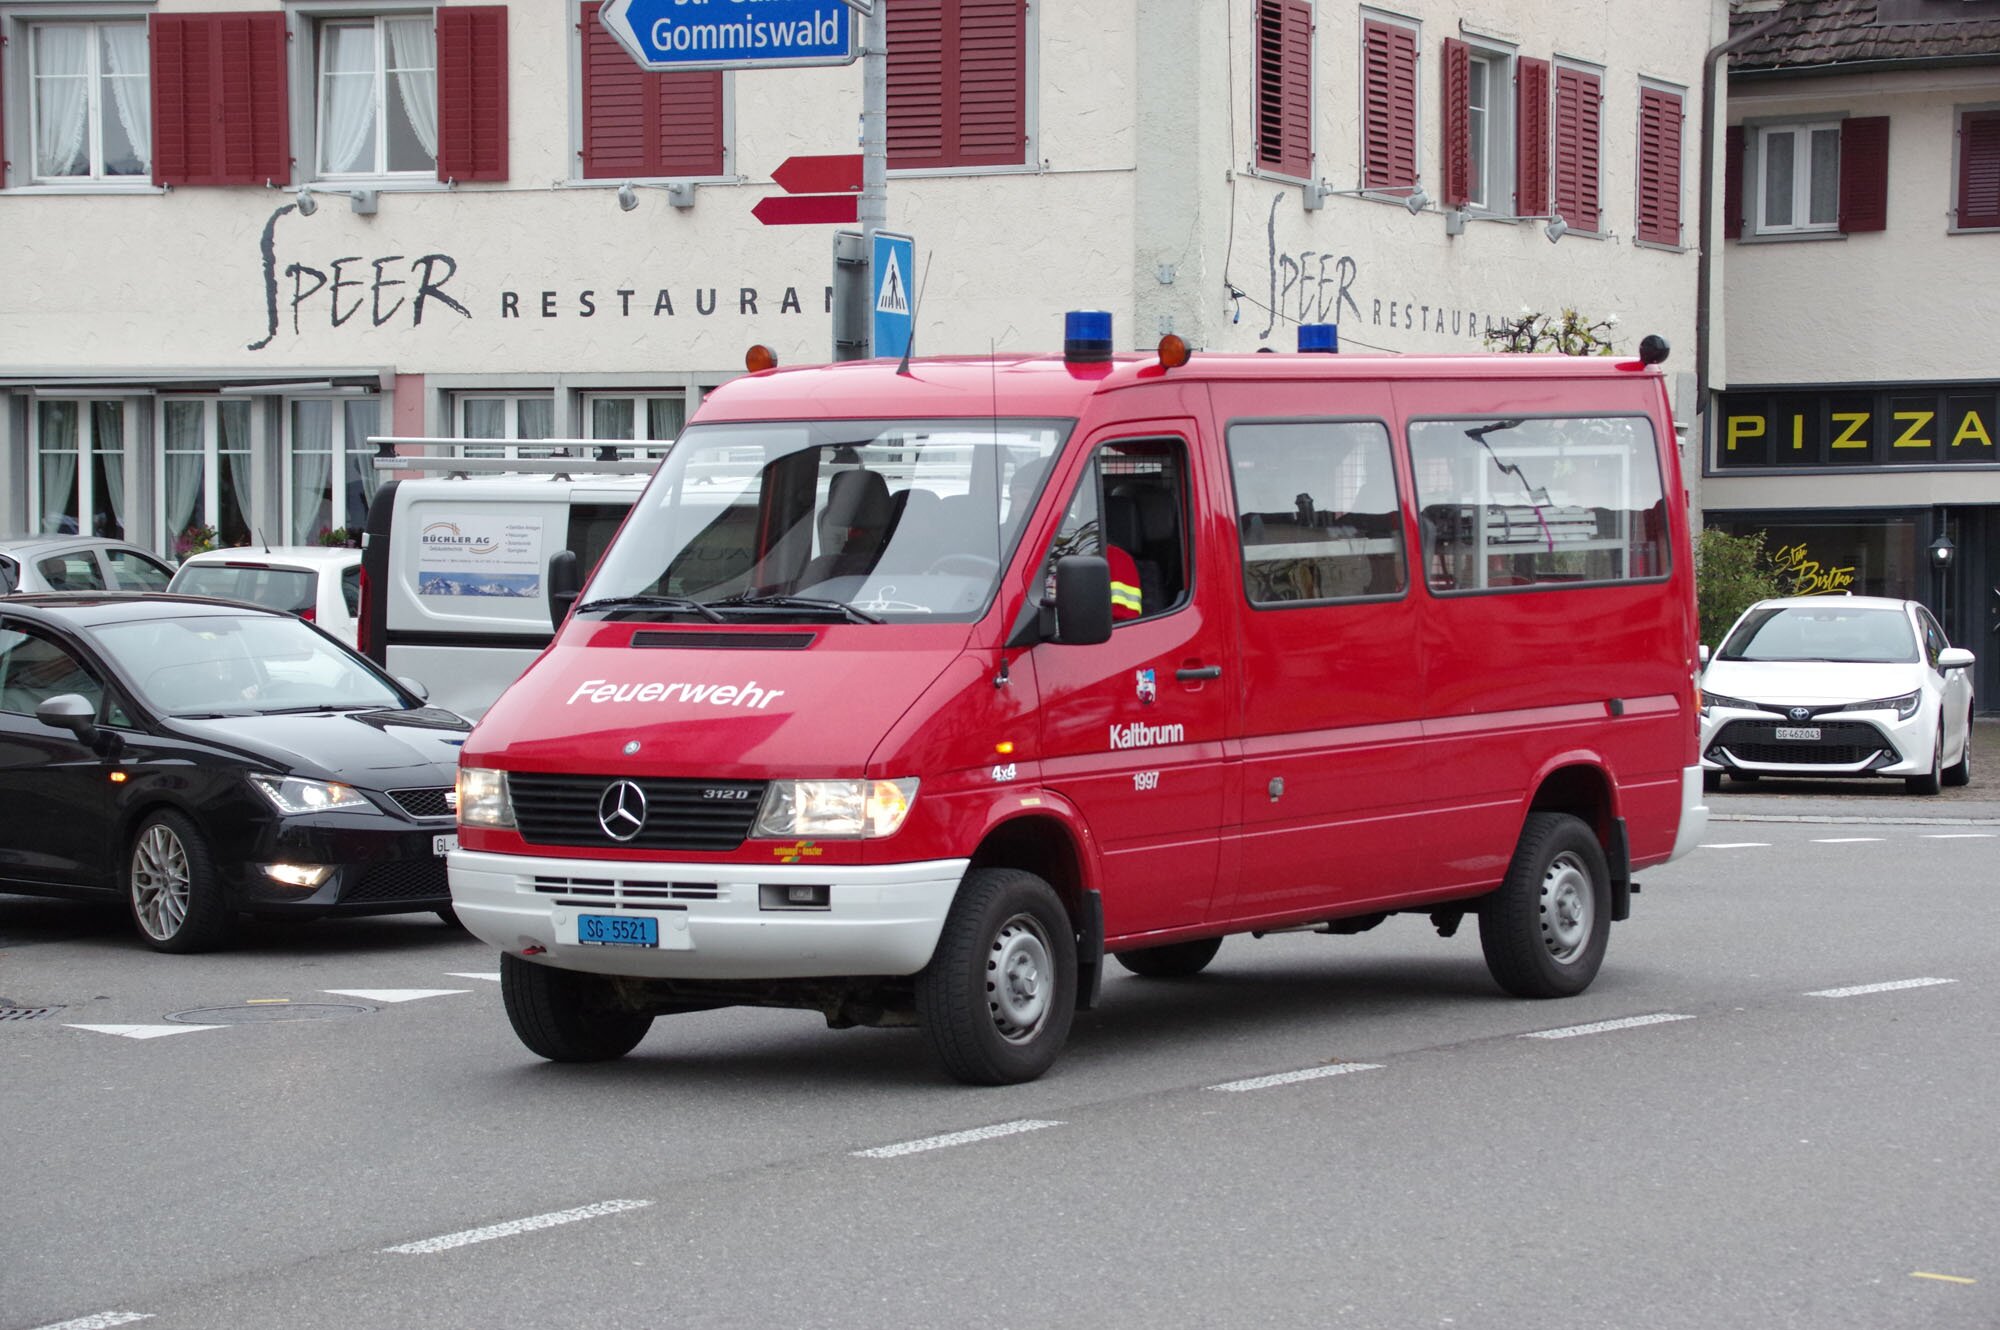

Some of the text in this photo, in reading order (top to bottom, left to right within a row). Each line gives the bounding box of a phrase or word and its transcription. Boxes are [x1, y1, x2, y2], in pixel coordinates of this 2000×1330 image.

[651, 9, 839, 51] Gommiswald
[247, 203, 473, 351] SPEER
[1258, 191, 1363, 340] SPEER
[1727, 410, 1993, 450] PIZZA
[422, 534, 490, 544] BÜCHLER AG
[1792, 560, 1856, 596] Bistro
[566, 679, 785, 710] Feuerwehr
[1109, 722, 1185, 750] Kaltbrunn
[991, 763, 1017, 782] 4x4
[1132, 771, 1160, 791] 1997
